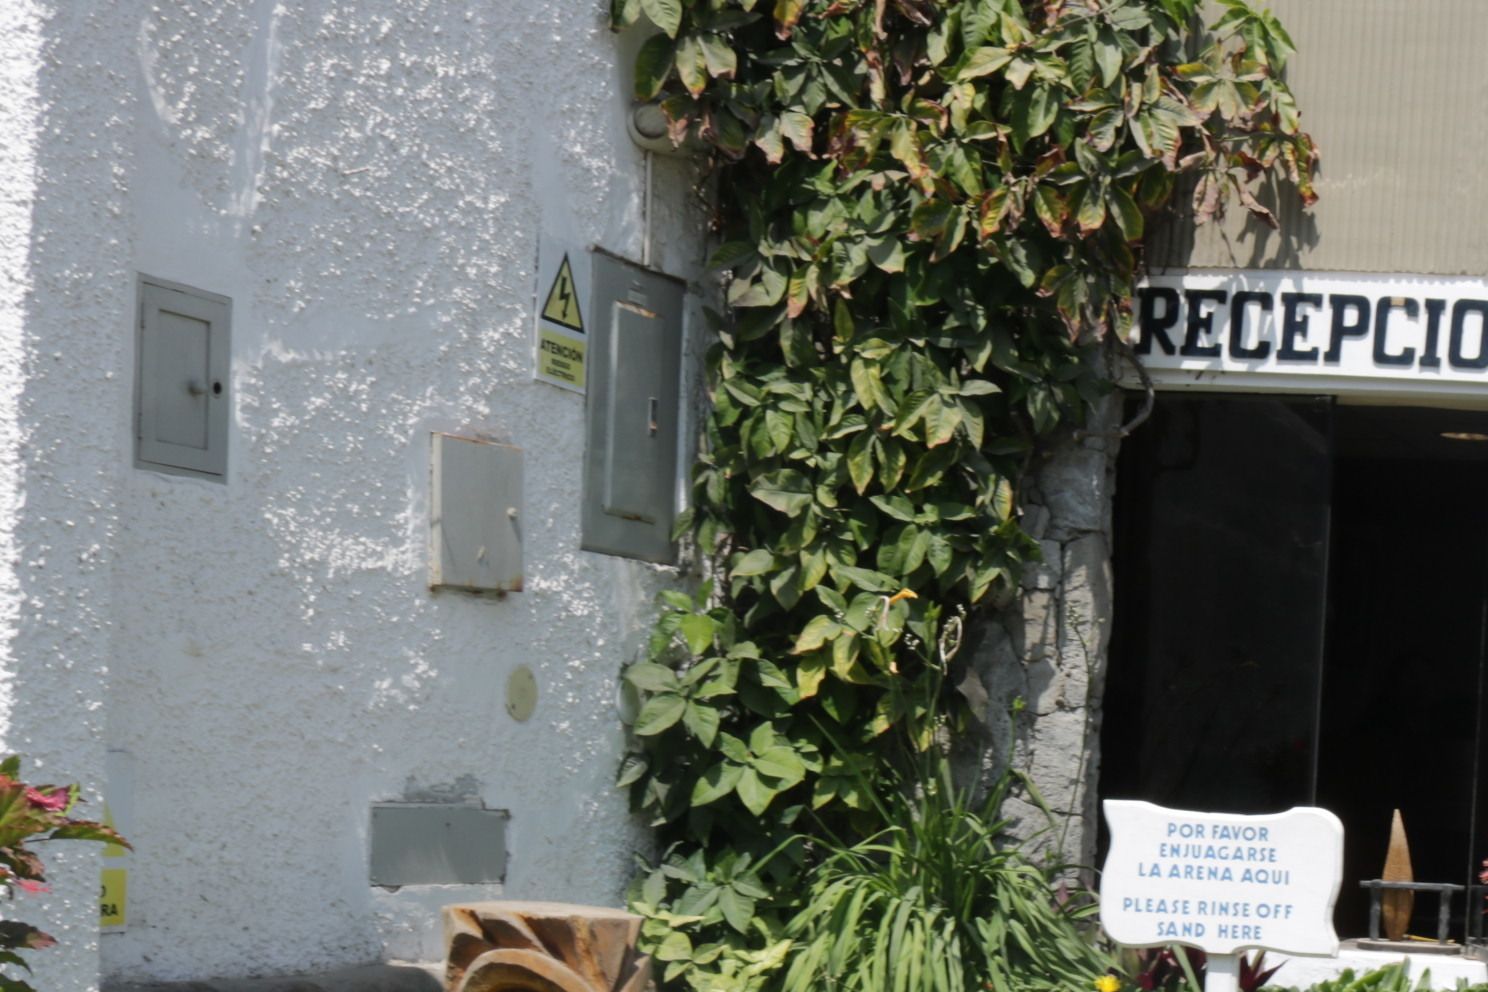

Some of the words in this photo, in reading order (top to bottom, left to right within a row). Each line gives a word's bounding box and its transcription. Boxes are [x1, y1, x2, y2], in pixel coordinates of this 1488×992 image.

[1167, 822, 1206, 839] POR
[1211, 824, 1270, 842] FAVOR
[1159, 843, 1278, 863] ENJUAGARSE
[1138, 862, 1161, 878] LA
[1168, 864, 1234, 882] ARENA
[1240, 868, 1291, 885] AQUI
[1122, 897, 1191, 915] PLEASE
[1197, 900, 1250, 918] RINSE
[1255, 903, 1294, 919] OFF
[1157, 921, 1206, 938] SAND
[1217, 923, 1264, 940] HERE
